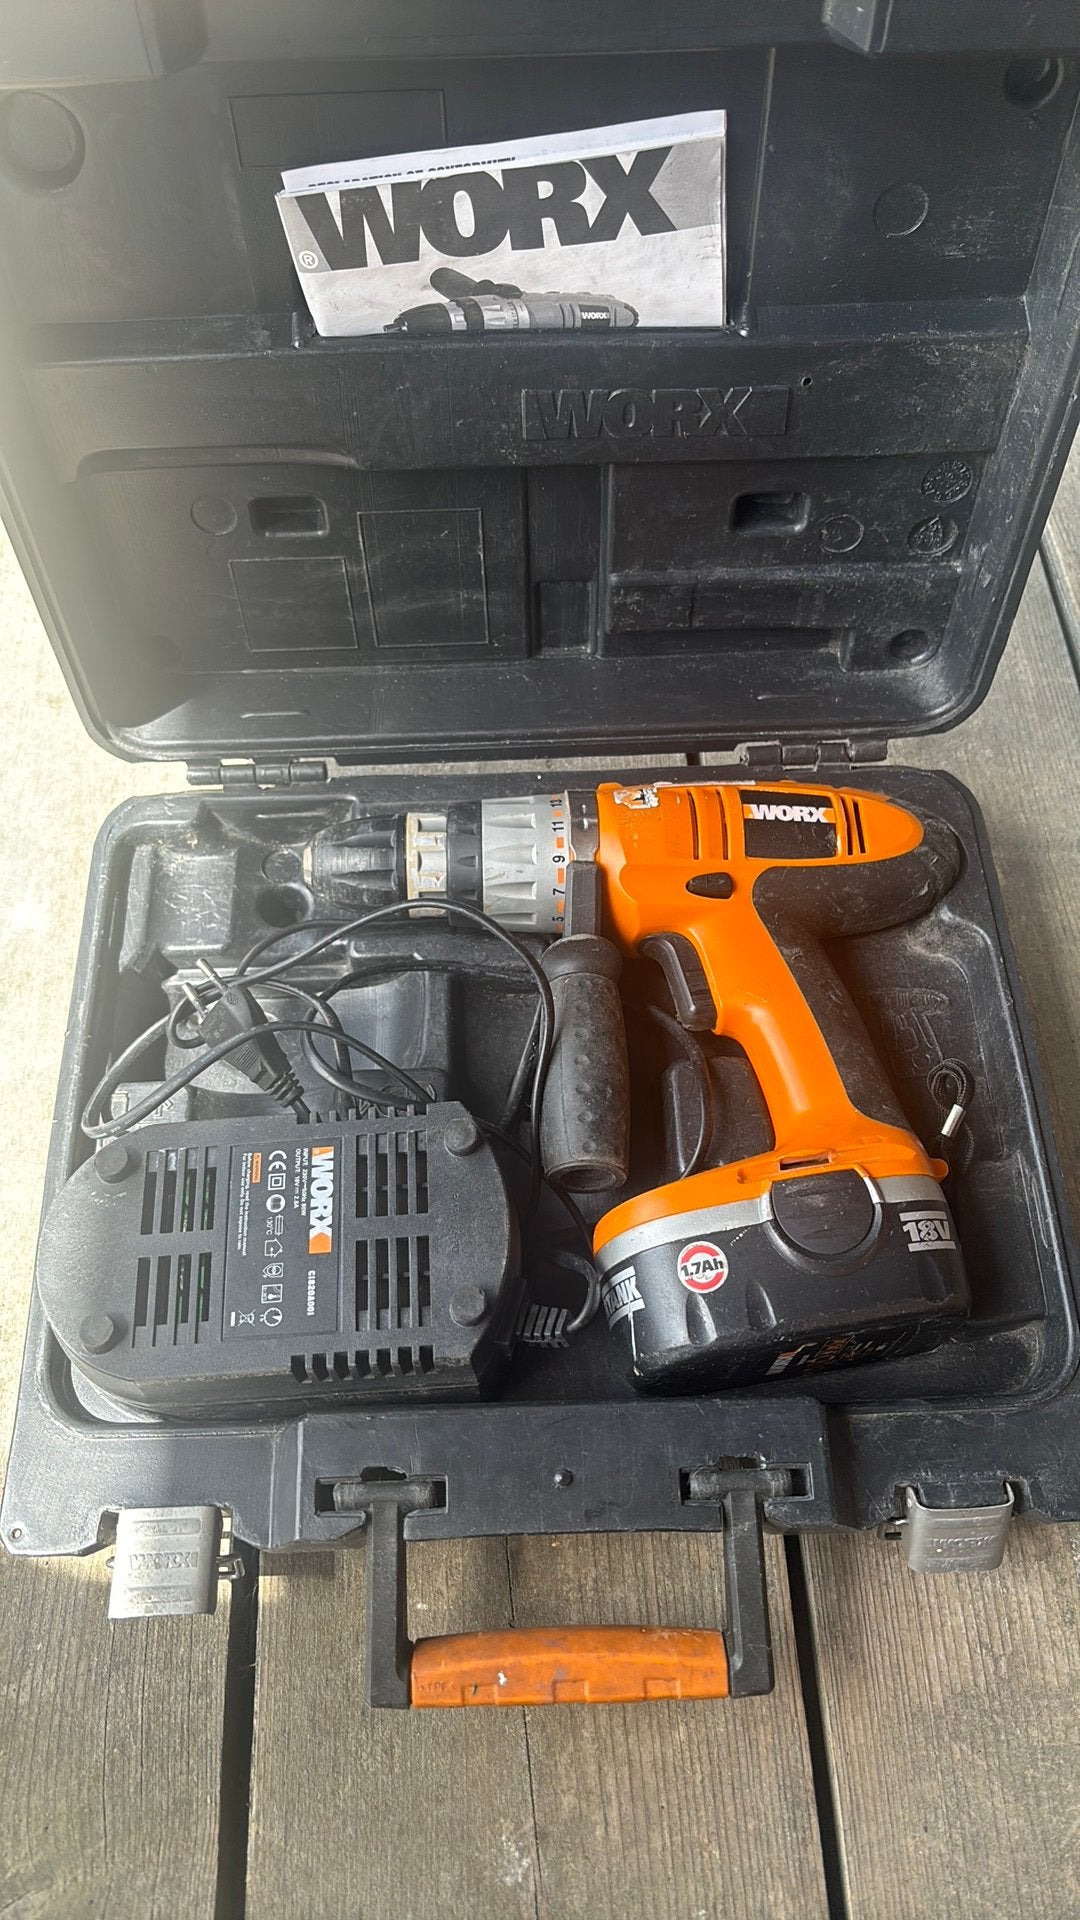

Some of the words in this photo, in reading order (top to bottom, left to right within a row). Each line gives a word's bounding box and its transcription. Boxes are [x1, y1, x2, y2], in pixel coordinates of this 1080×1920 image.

[295, 146, 679, 272] WORX
[581, 311, 607, 320] WORX
[535, 387, 752, 441] WORX
[550, 798, 563, 808] 13
[748, 803, 830, 824] WORX
[552, 821, 565, 833] 11
[552, 854, 566, 864] 9
[552, 887, 566, 896] 7
[551, 915, 565, 923] 5
[309, 1149, 335, 1240] WORX
[902, 1219, 951, 1242] 18V
[680, 1257, 725, 1278] 1.7Ah
